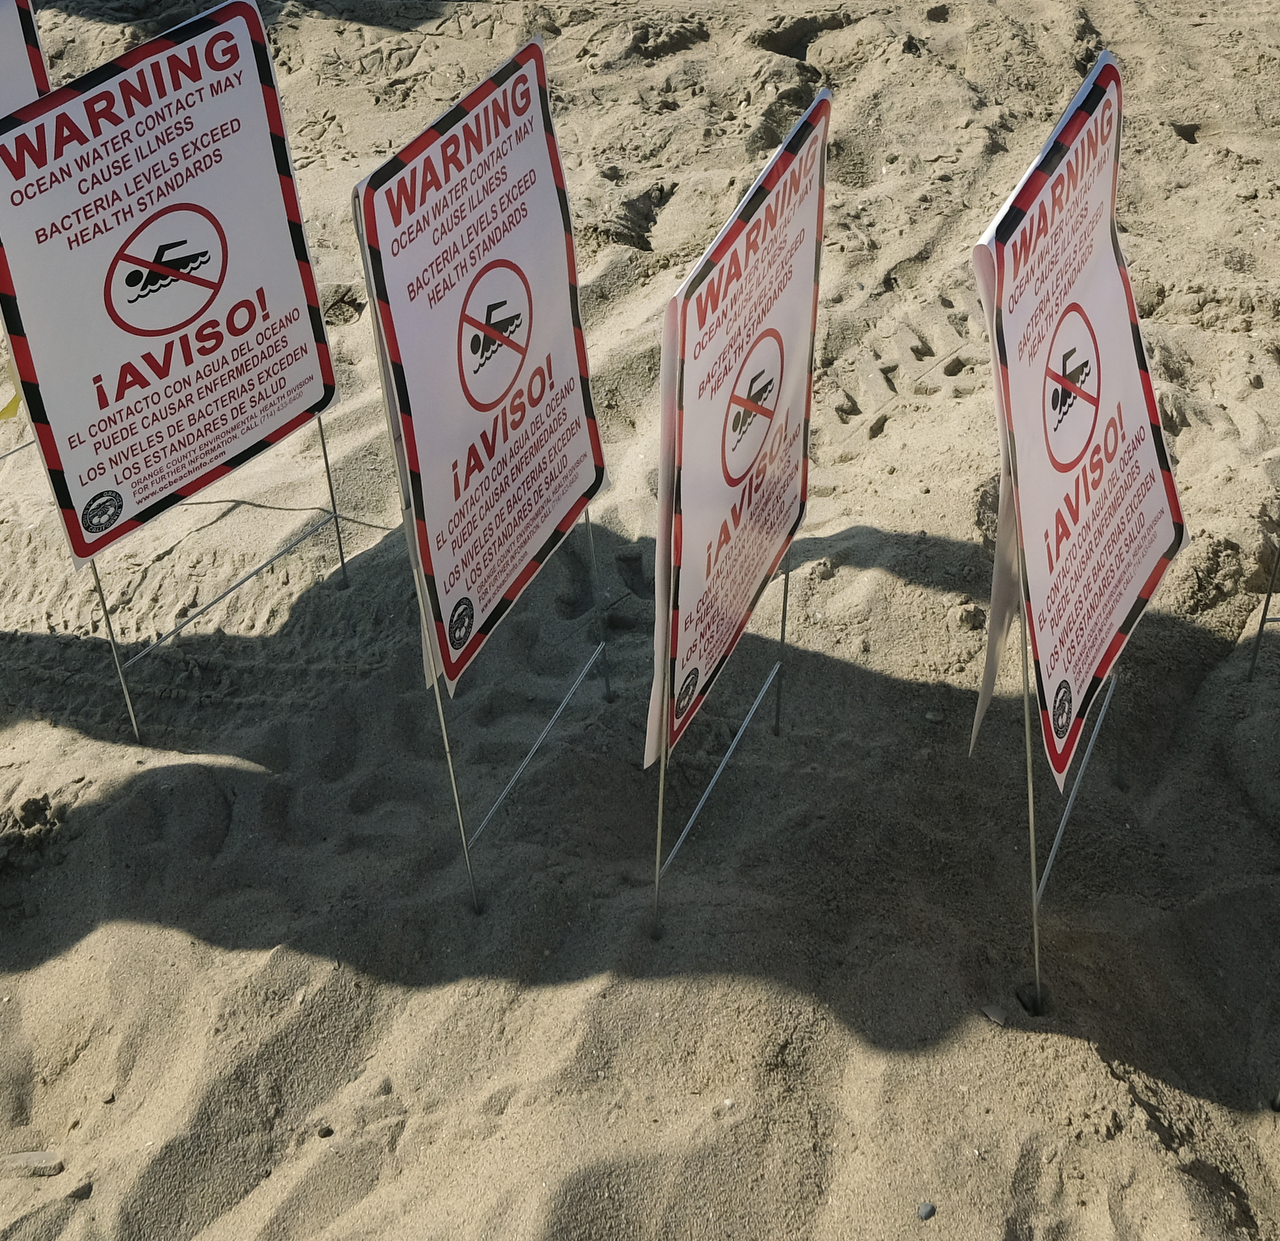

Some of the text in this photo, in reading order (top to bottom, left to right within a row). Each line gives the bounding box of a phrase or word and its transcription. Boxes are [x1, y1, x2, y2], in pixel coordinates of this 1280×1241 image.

[9, 68, 243, 207] OCEAN WATER CONTACT MAY
[34, 117, 241, 244] BACTERIA LEVELS EXCEED
[66, 147, 223, 251] HEALTH STANDARDS
[77, 114, 194, 195] CAUSE ILLNESS
[384, 73, 531, 227] WARNING
[390, 114, 534, 257] OCEAN WATER CONTACT MAY
[431, 164, 508, 246] CAUSE ILLNESS
[1011, 97, 1113, 280] WARNING
[695, 134, 818, 330] WARNING
[67, 307, 300, 450] EL CONTACTO CON AGUA DEL OCEANO
[78, 341, 308, 487] LOS NIVELES DE BACTERIAS EXCEDEN
[92, 286, 270, 410] ¡AVISO!
[92, 334, 288, 456] PUEDE CAUSAR ENFERMEDADES
[113, 375, 287, 486] LOS ESTANDARES DE SALUD
[451, 353, 555, 501] ¡AVISO!
[704, 406, 790, 580] ¡AVISO!
[1043, 401, 1126, 574] ¡AVISO!
